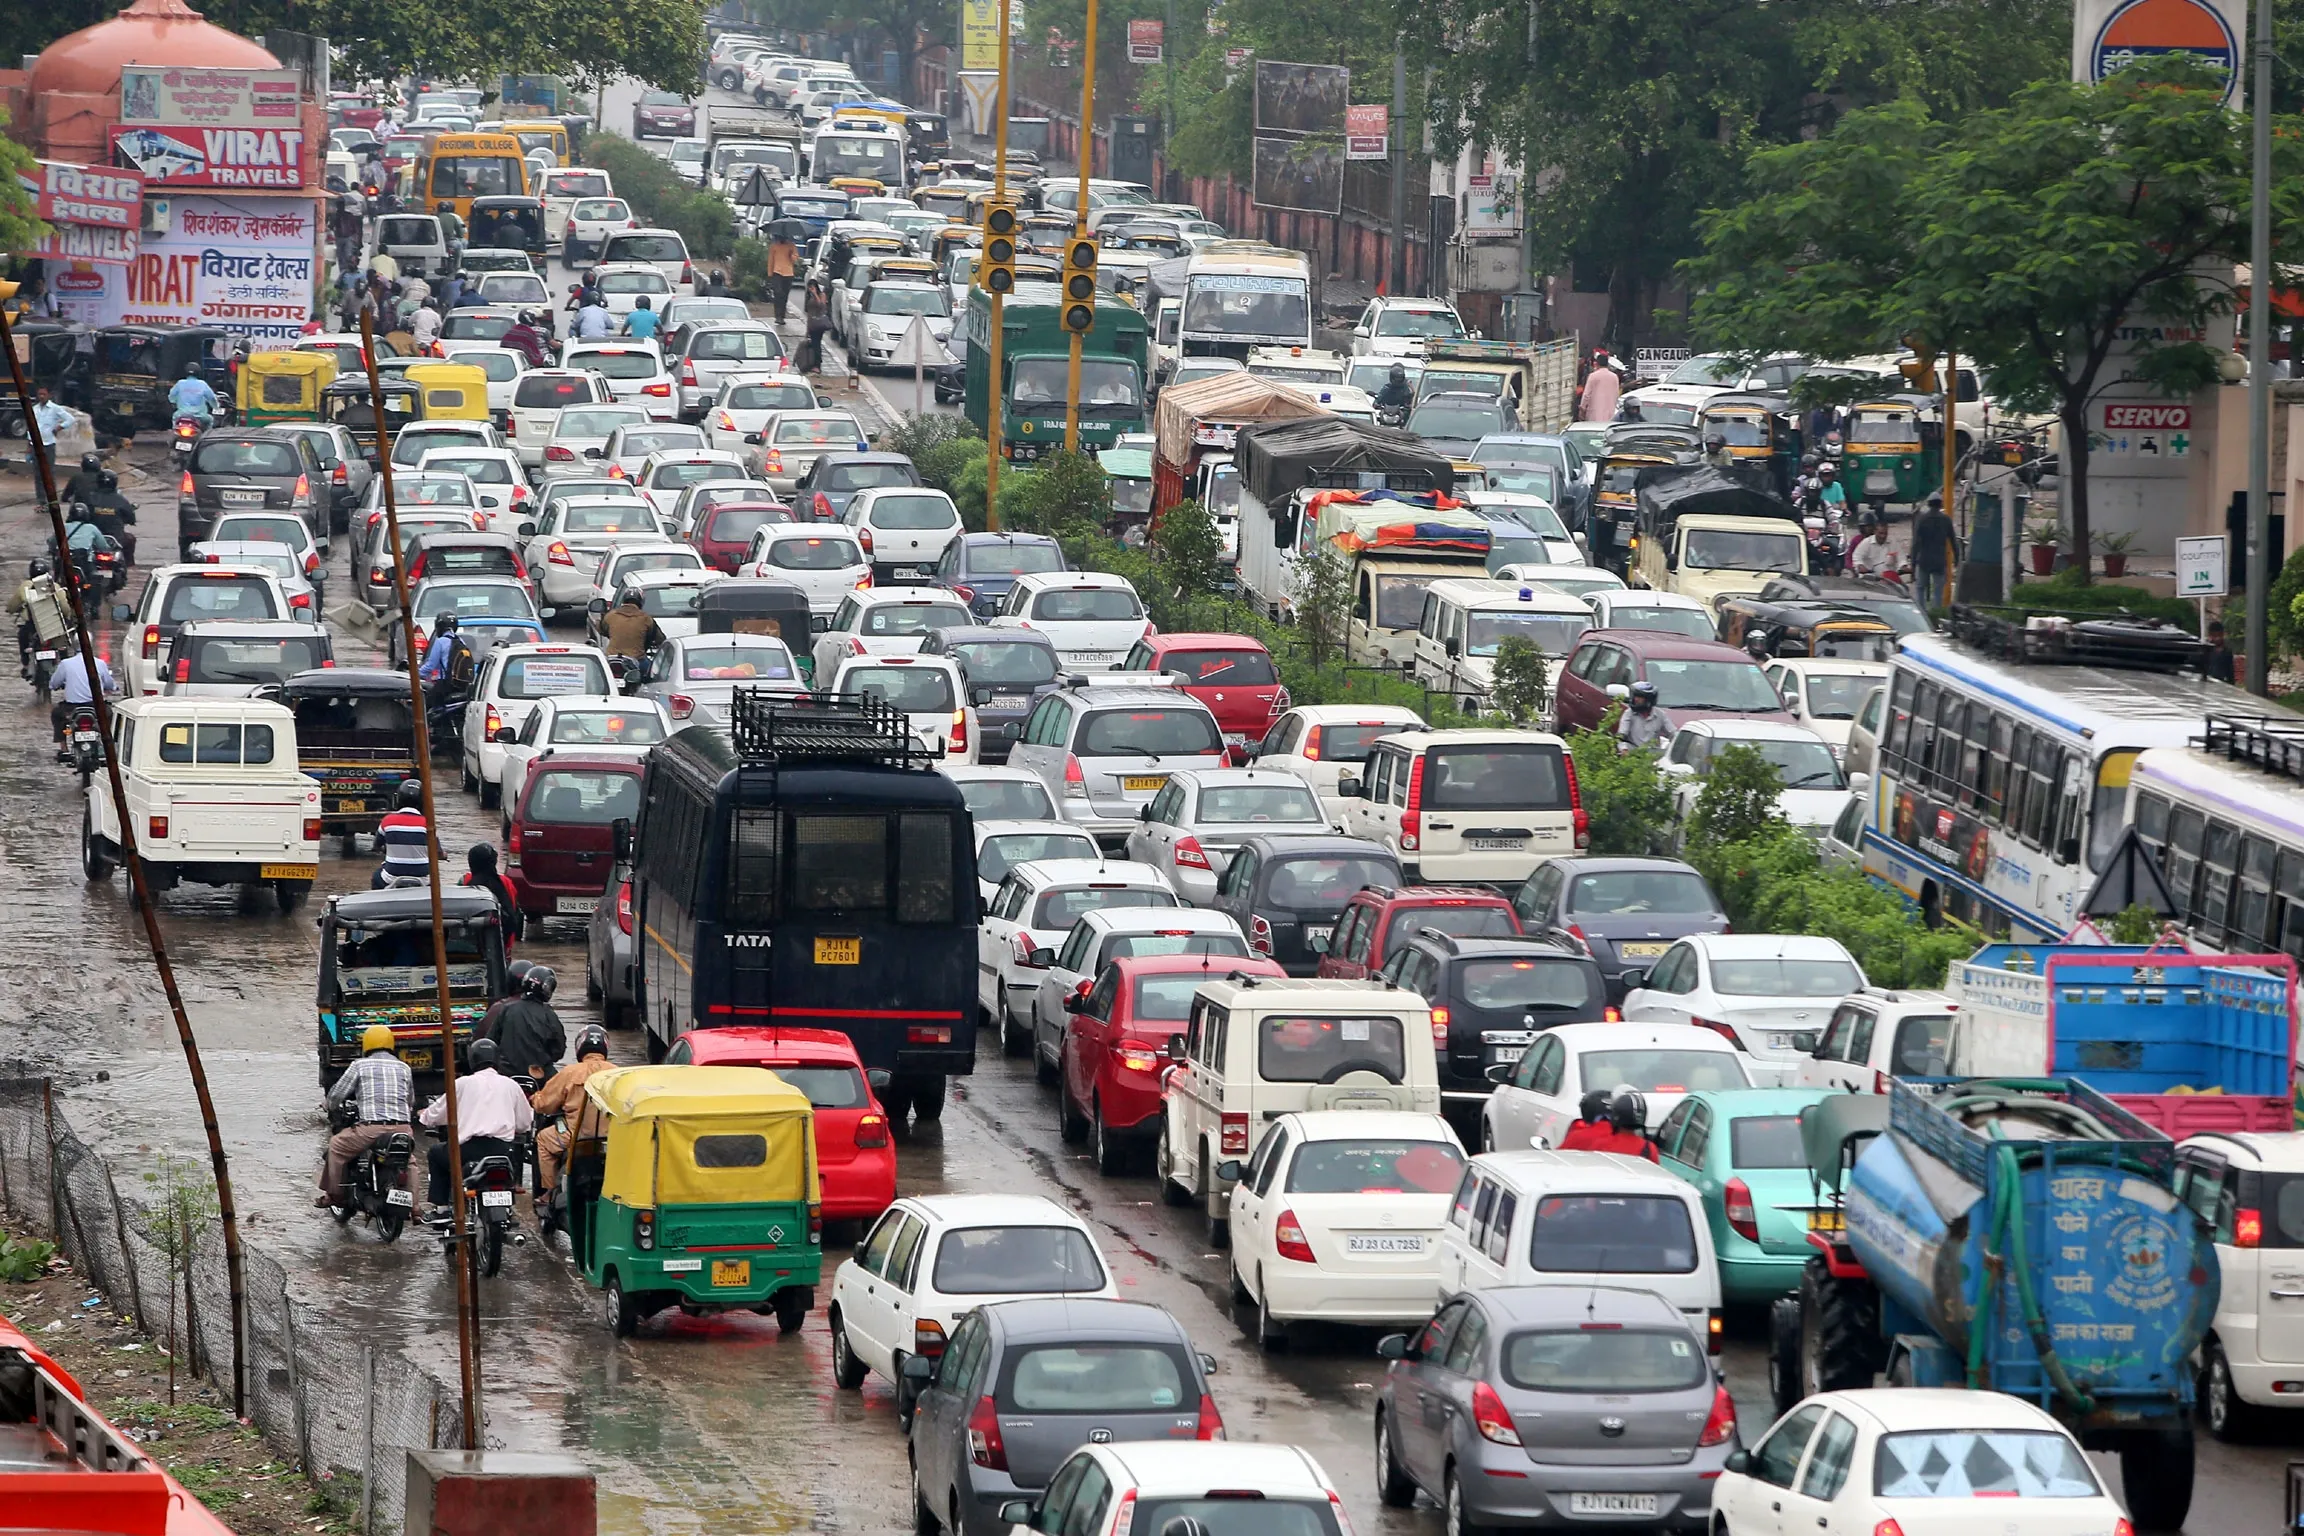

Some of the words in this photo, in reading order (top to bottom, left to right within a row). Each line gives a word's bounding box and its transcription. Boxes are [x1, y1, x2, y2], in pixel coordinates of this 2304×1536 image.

[202, 129, 302, 166] VIRAT
[439, 139, 477, 150] REGIONAL
[478, 139, 514, 150] COLLEGE
[45, 164, 140, 204] विराट
[209, 168, 299, 184] TRAVELS
[182, 209, 208, 236] शिव
[208, 211, 241, 238] शंकर
[60, 226, 137, 261] TRAVELS
[201, 248, 262, 279] विराट
[264, 252, 310, 282] ट्रेवल्स
[126, 253, 199, 307] VIRAT
[1195, 276, 1300, 292] TOURIST
[201, 298, 306, 321] गंगानगर
[1637, 349, 1691, 360] GANGAUR
[2109, 408, 2186, 426] SERVO
[2194, 571, 2208, 581] IN
[332, 769, 374, 777] PIAGGIO
[329, 782, 373, 790] VOLVO
[724, 935, 771, 947] TATA
[826, 939, 850, 950] RJ14
[821, 950, 857, 962] PC7601
[2051, 1178, 2106, 1201] यादव
[2053, 1210, 2089, 1232] पीने
[1350, 1240, 1363, 1251] RJ
[2061, 1246, 2087, 1262] का
[2052, 1270, 2094, 1294] पानी
